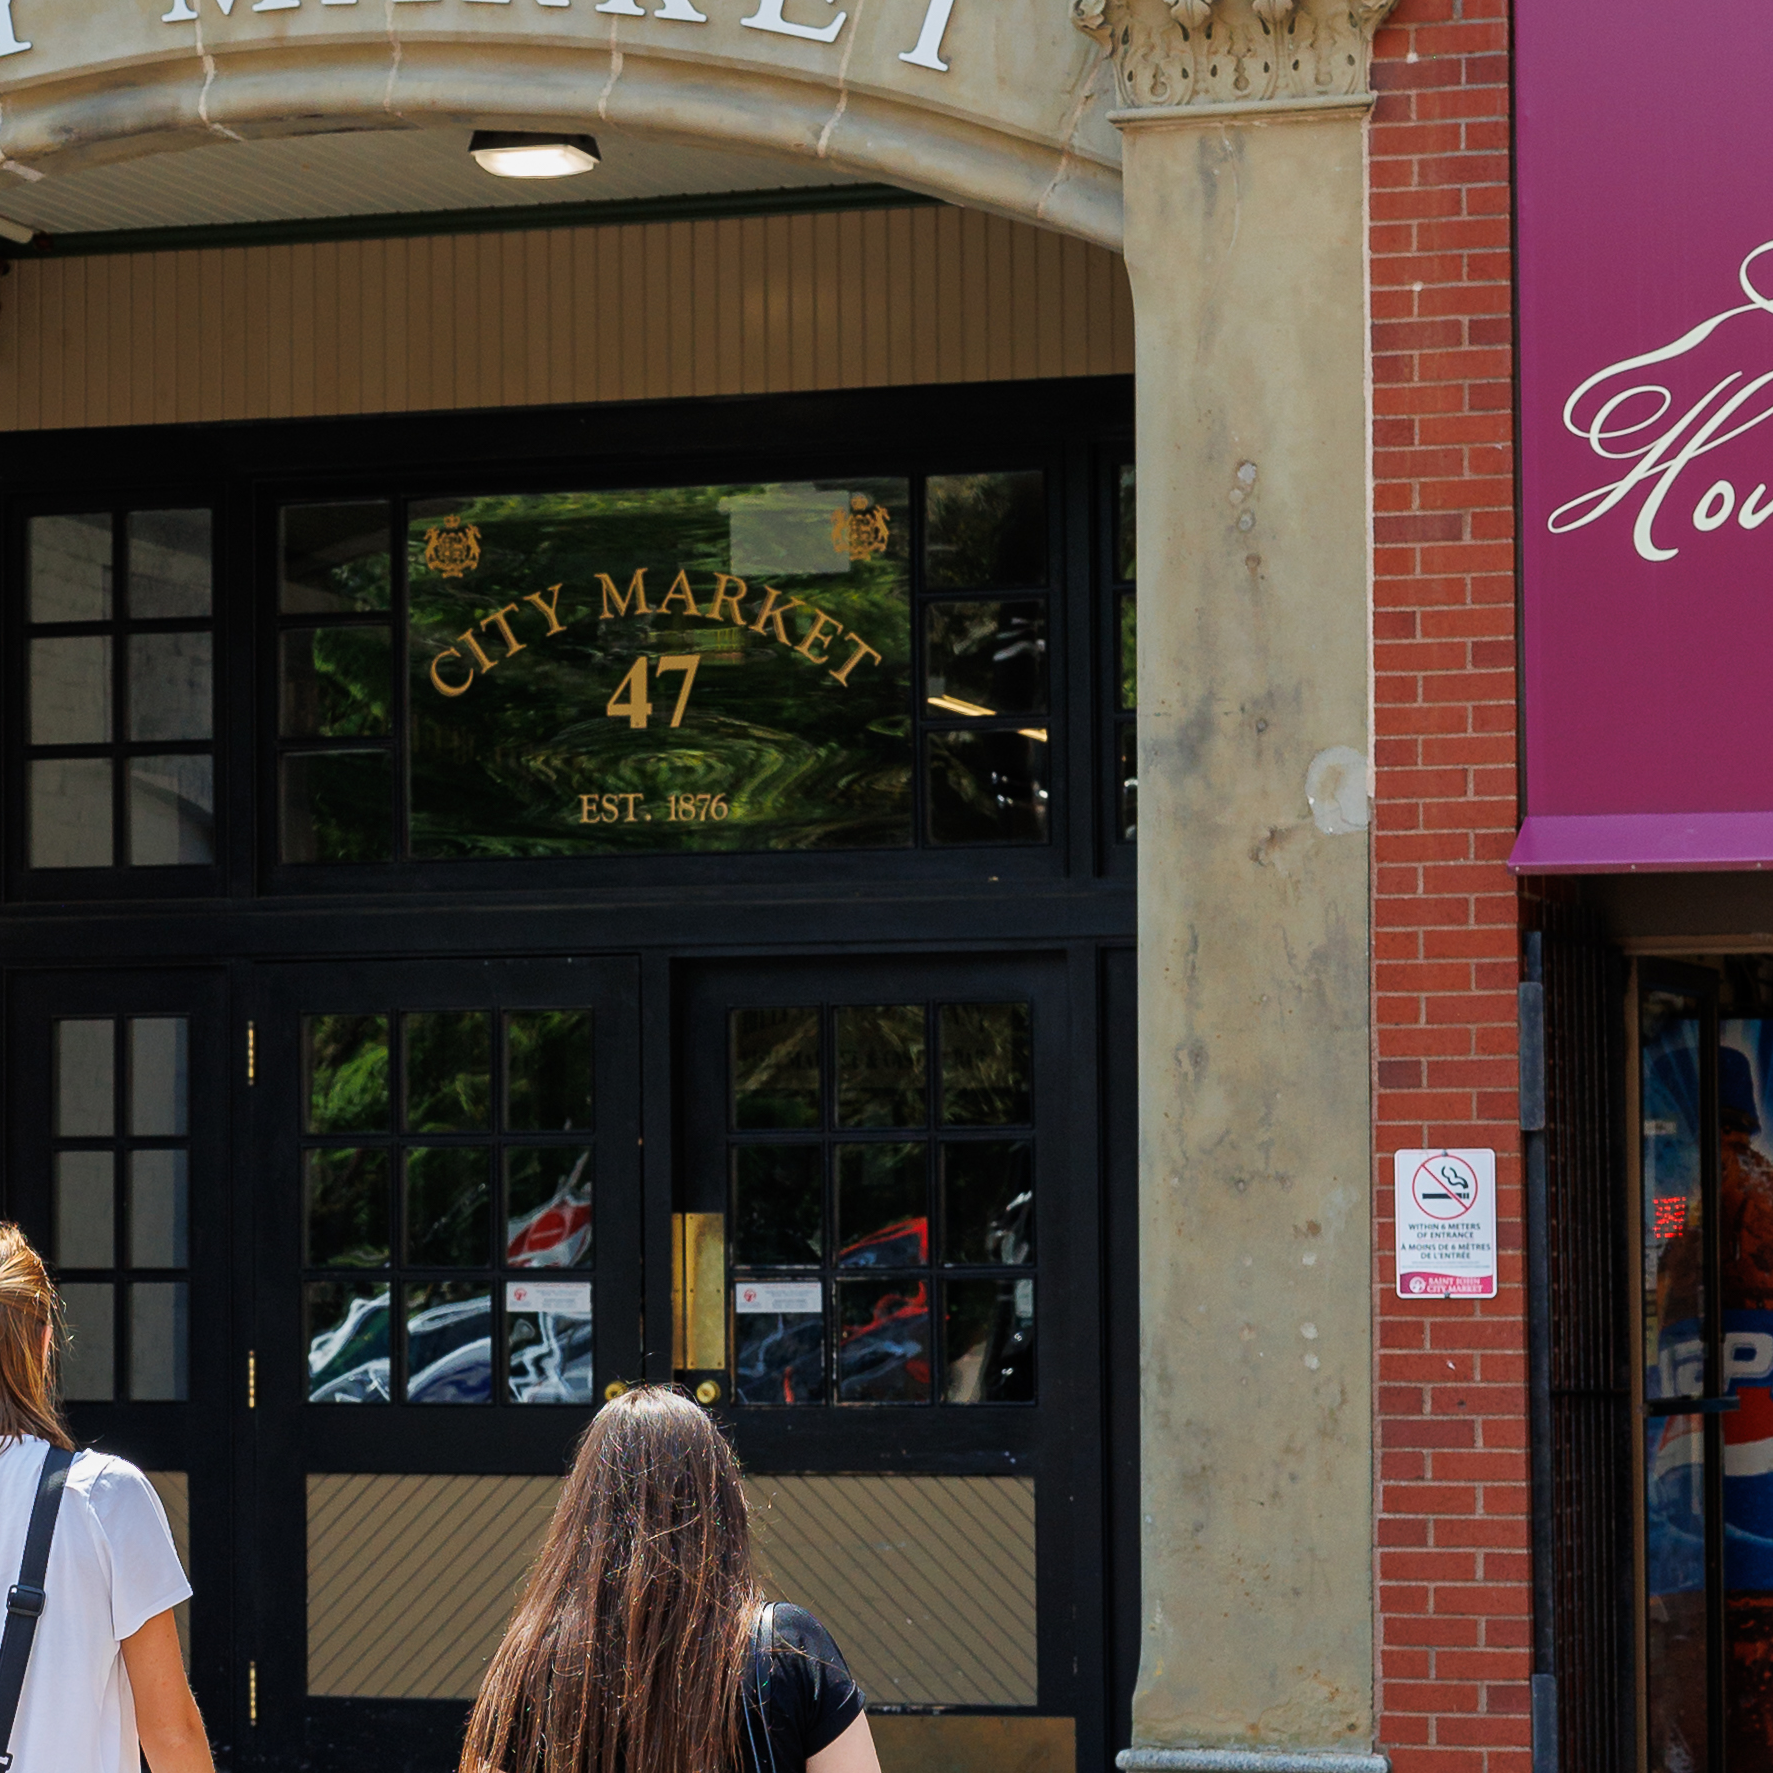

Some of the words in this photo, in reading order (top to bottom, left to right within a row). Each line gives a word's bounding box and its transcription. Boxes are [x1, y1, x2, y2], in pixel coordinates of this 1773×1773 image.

[429, 583, 567, 697] CITY
[594, 567, 882, 688] MARKET
[606, 654, 701, 728] 47
[579, 793, 652, 824] EST.
[666, 793, 729, 822] 1876
[1408, 1223, 1439, 1231] WITHIN
[1416, 1231, 1428, 1239] OF
[1430, 1231, 1474, 1239] ENTRANCE
[1408, 1243, 1436, 1251] MOINS
[1438, 1243, 1449, 1251] DE
[1420, 1252, 1431, 1260] DE
